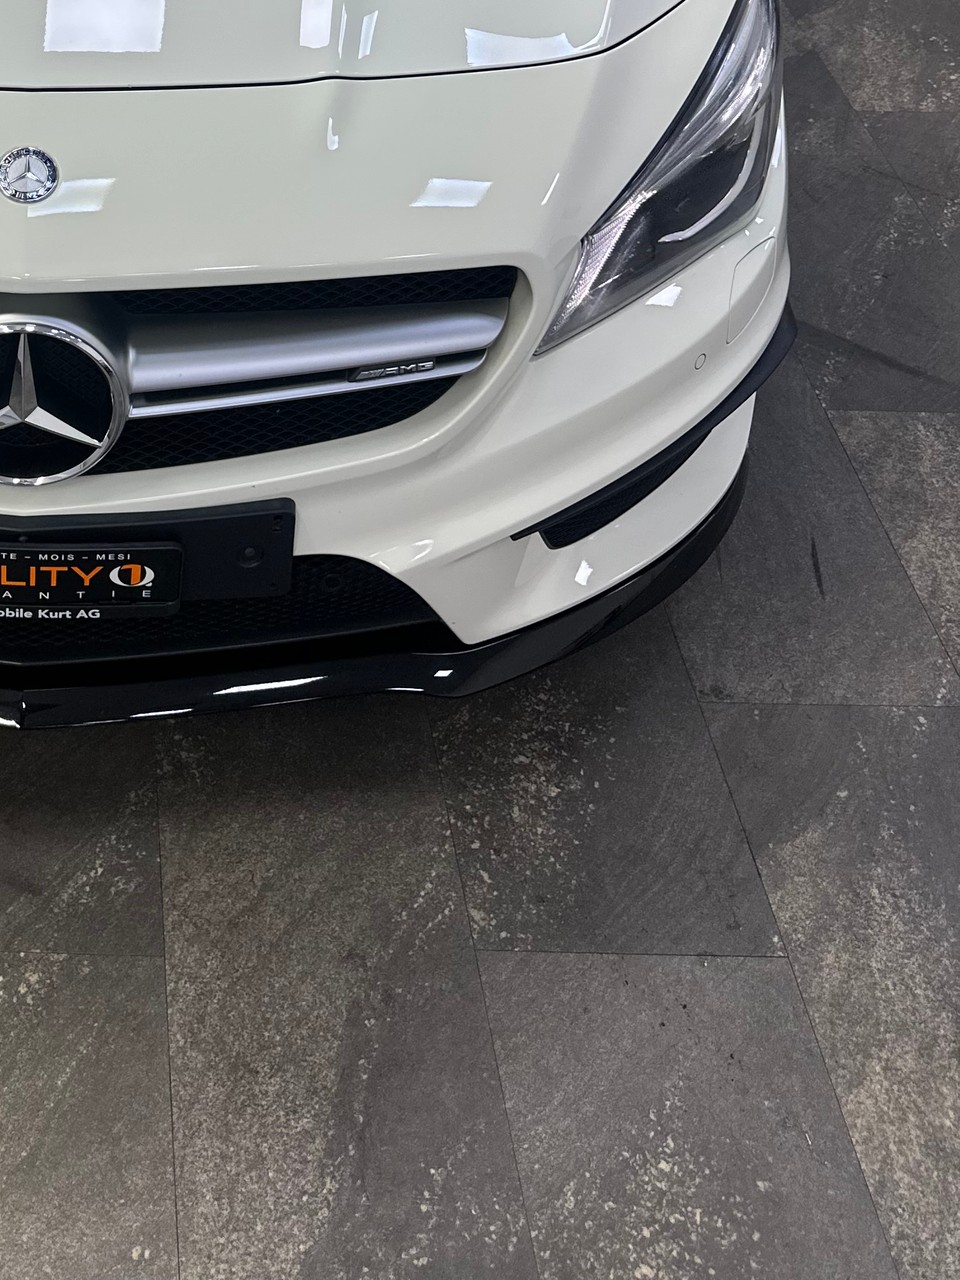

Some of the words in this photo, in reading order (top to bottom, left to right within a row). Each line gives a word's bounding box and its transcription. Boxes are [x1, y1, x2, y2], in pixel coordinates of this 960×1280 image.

[38, 553, 75, 561] MOIS
[96, 553, 131, 561] MESI
[38, 608, 72, 619] Kurt
[75, 609, 101, 619] AG
